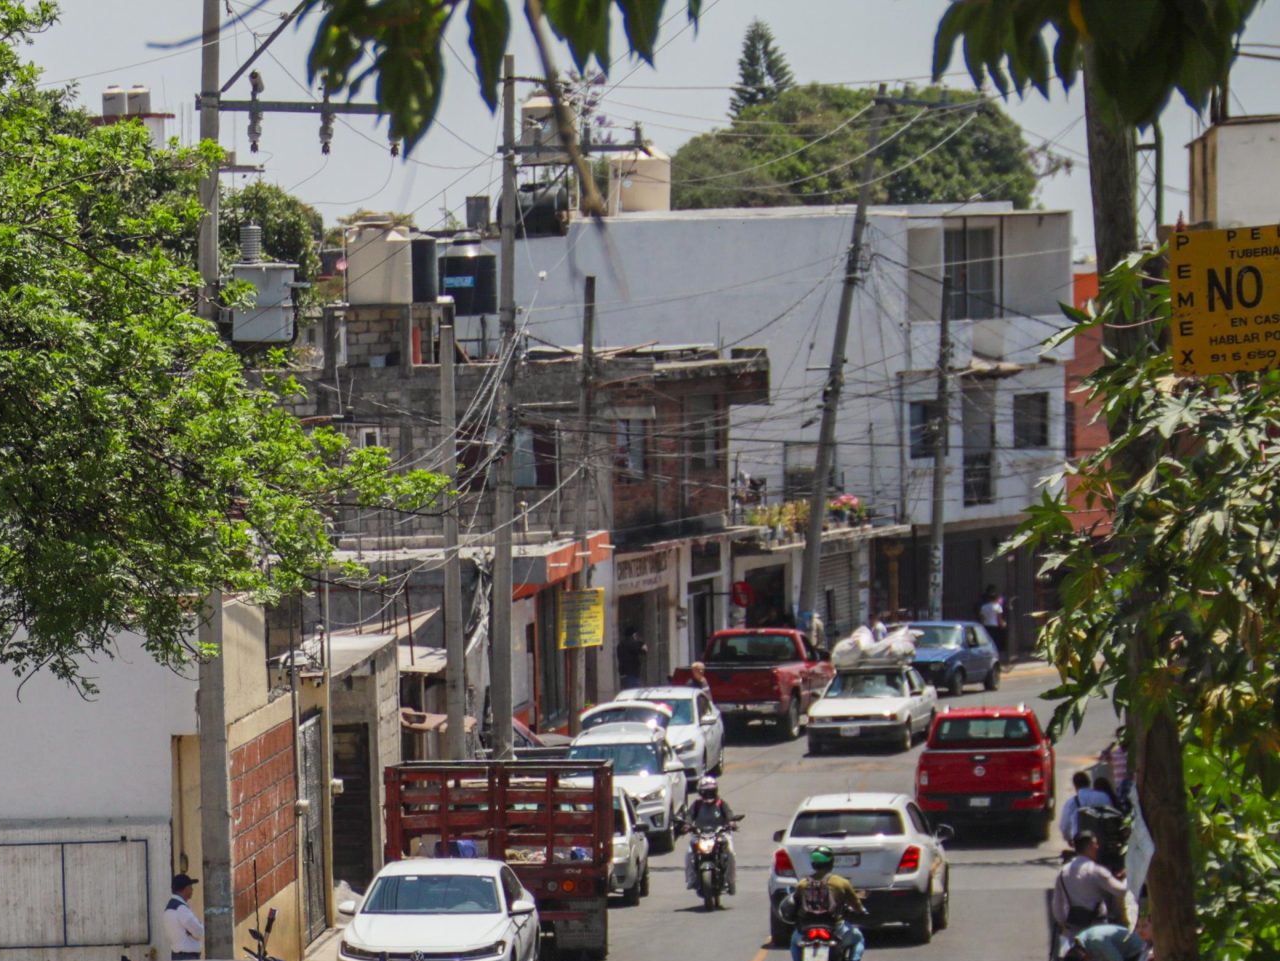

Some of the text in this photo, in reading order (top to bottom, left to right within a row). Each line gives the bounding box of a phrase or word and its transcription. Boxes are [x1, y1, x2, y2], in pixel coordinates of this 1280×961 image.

[1207, 265, 1263, 312] NO
[1231, 317, 1248, 327] EN
[1209, 333, 1260, 346] HABLAR
